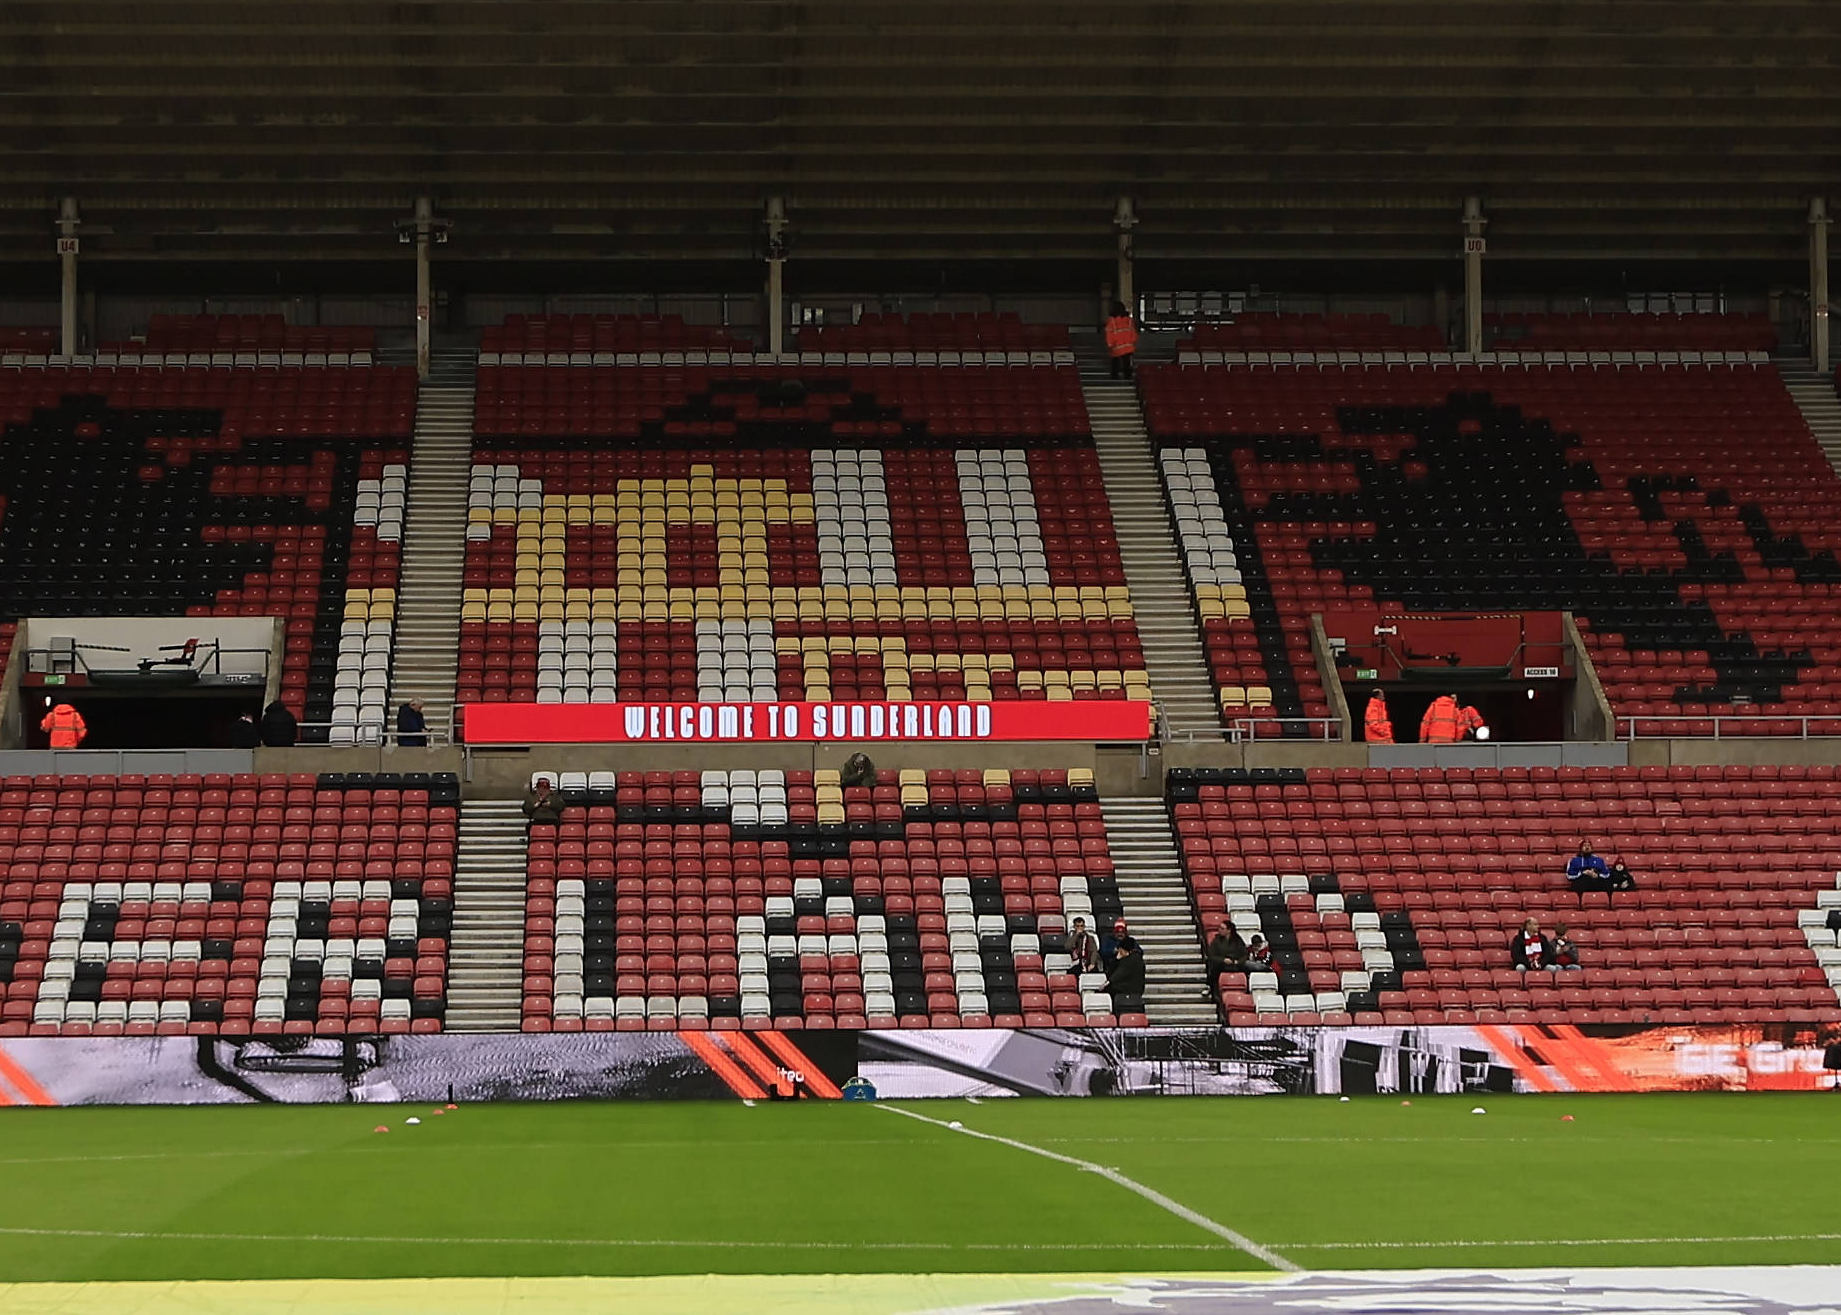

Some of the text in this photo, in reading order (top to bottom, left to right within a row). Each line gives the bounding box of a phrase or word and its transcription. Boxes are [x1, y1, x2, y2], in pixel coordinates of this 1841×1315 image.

[623, 703, 992, 739] WELCOME TO SUNDERLAND
